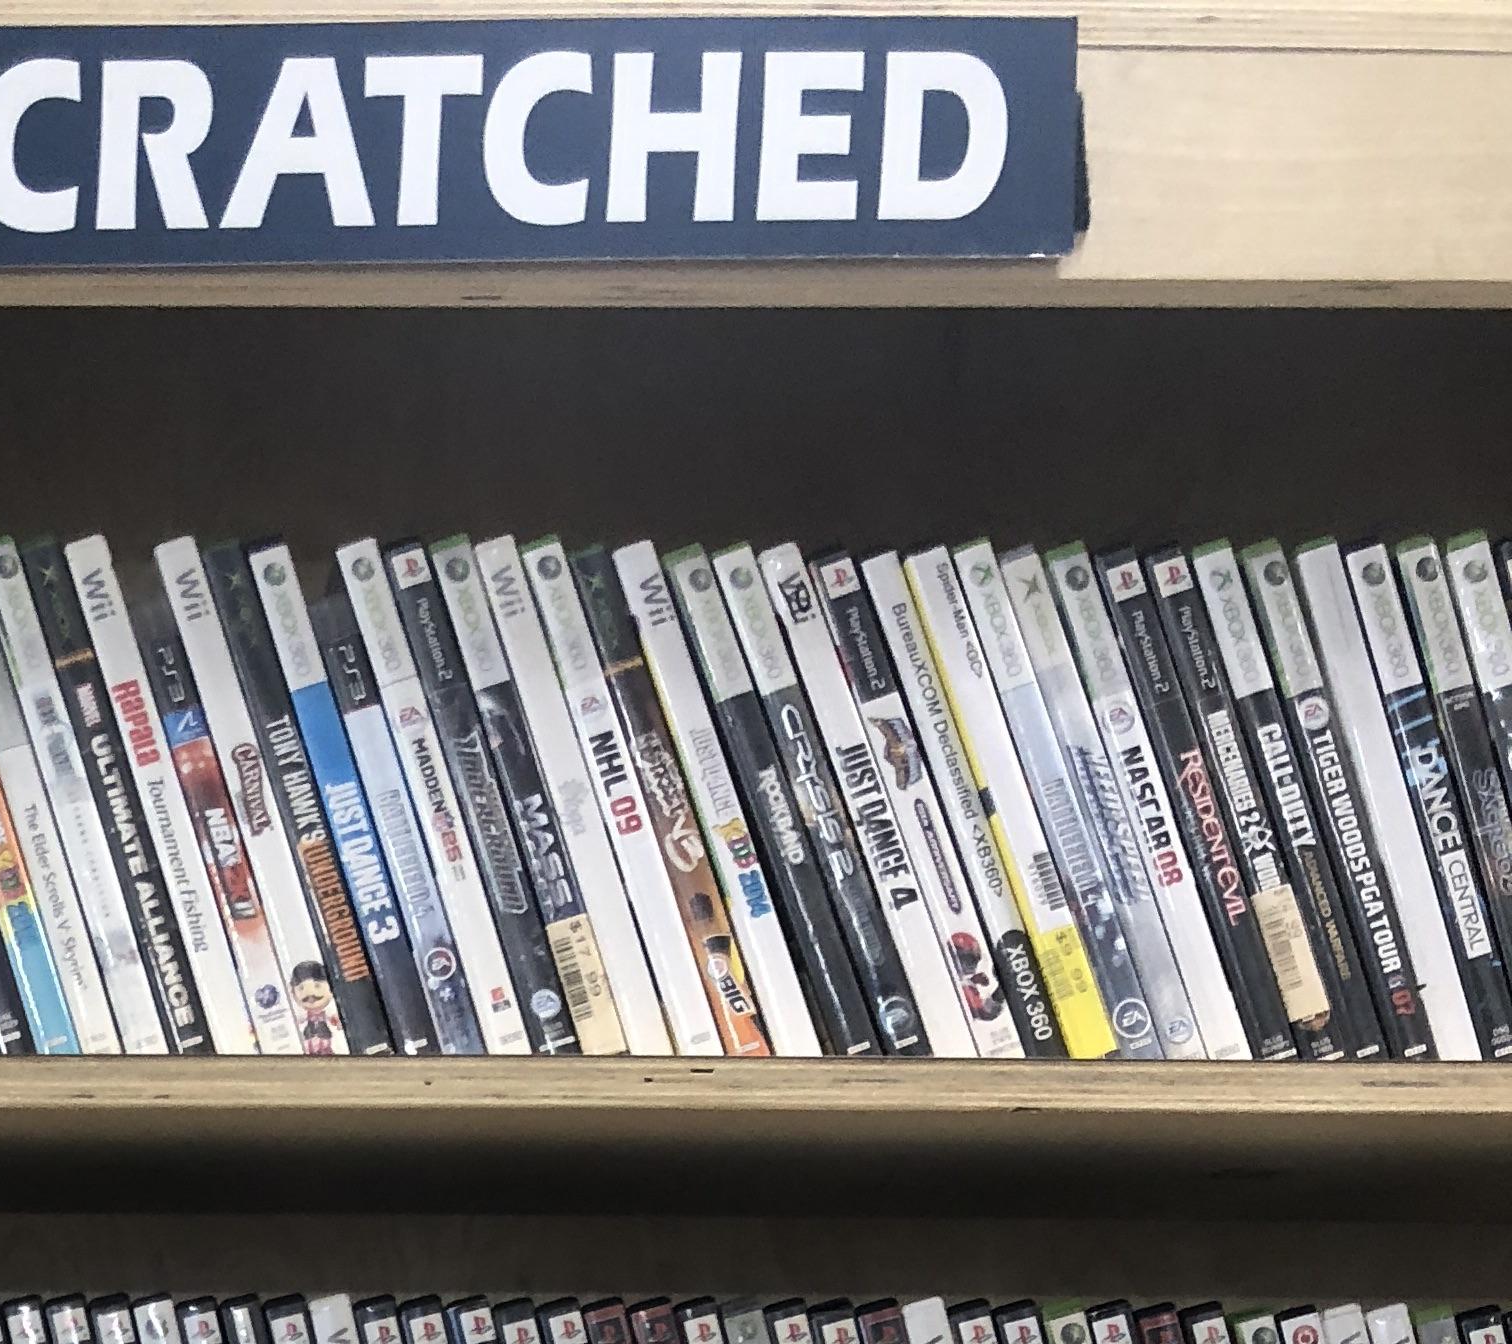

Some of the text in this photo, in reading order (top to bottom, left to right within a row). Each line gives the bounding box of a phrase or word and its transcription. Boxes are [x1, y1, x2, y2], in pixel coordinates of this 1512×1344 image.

[935, 563, 985, 680] Spider-Man <GC>
[588, 731, 643, 836] NHL 09
[837, 743, 918, 910] JUST DANCE 4
[890, 602, 1004, 898] BureauXCOM Declassified <XB360>
[90, 734, 195, 1028] ULTIMATE ALLIANCE
[145, 779, 187, 886] Tournament
[178, 889, 212, 953] Fishing
[266, 715, 371, 982] TONY HAWK'S UNDERGROUND
